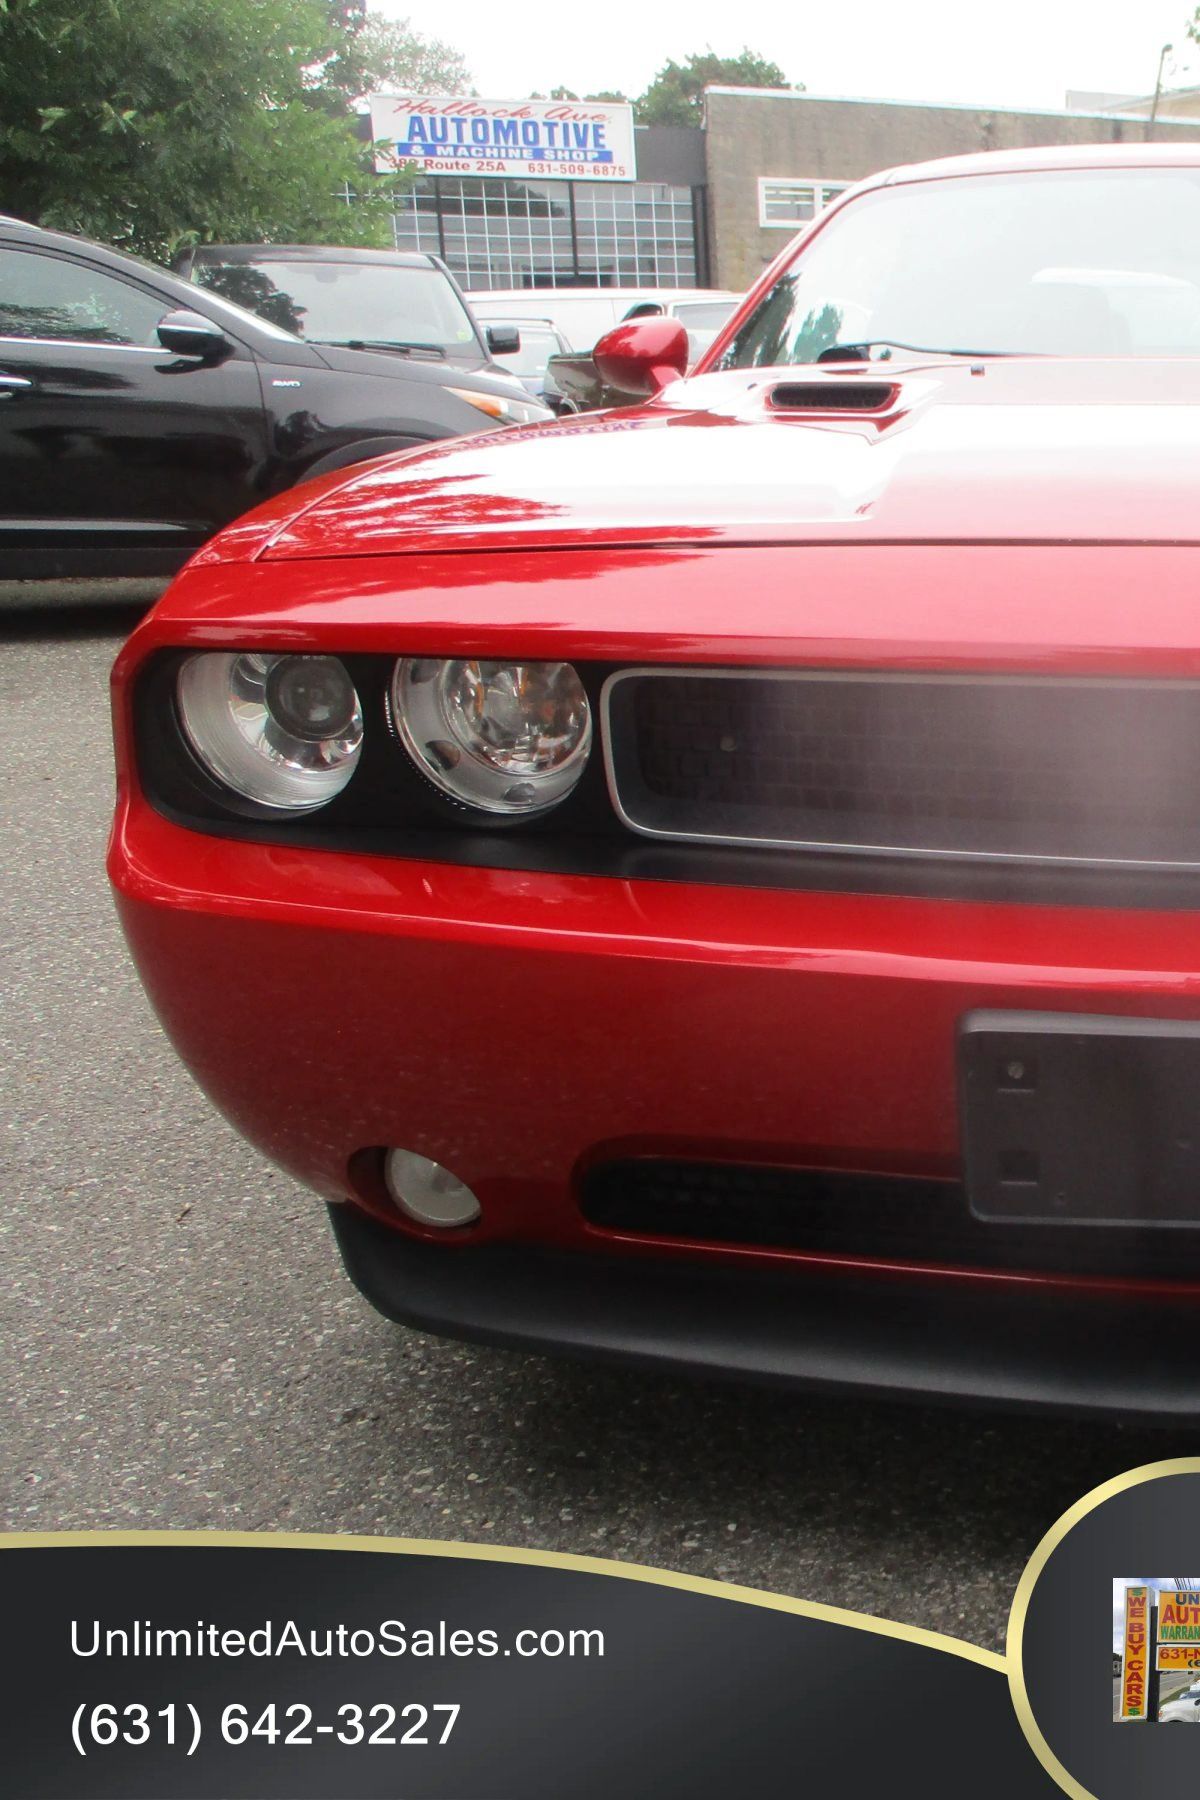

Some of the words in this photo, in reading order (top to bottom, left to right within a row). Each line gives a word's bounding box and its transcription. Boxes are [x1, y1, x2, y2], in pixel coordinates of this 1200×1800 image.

[393, 100, 534, 120] Hallock
[407, 115, 607, 149] AUTOMOTIVE
[410, 144, 426, 156] &
[436, 145, 534, 159] MACHINE
[544, 148, 599, 161] SHOP
[424, 159, 470, 171] Route
[476, 161, 506, 172] 25A
[528, 162, 626, 177] 631-509-6875
